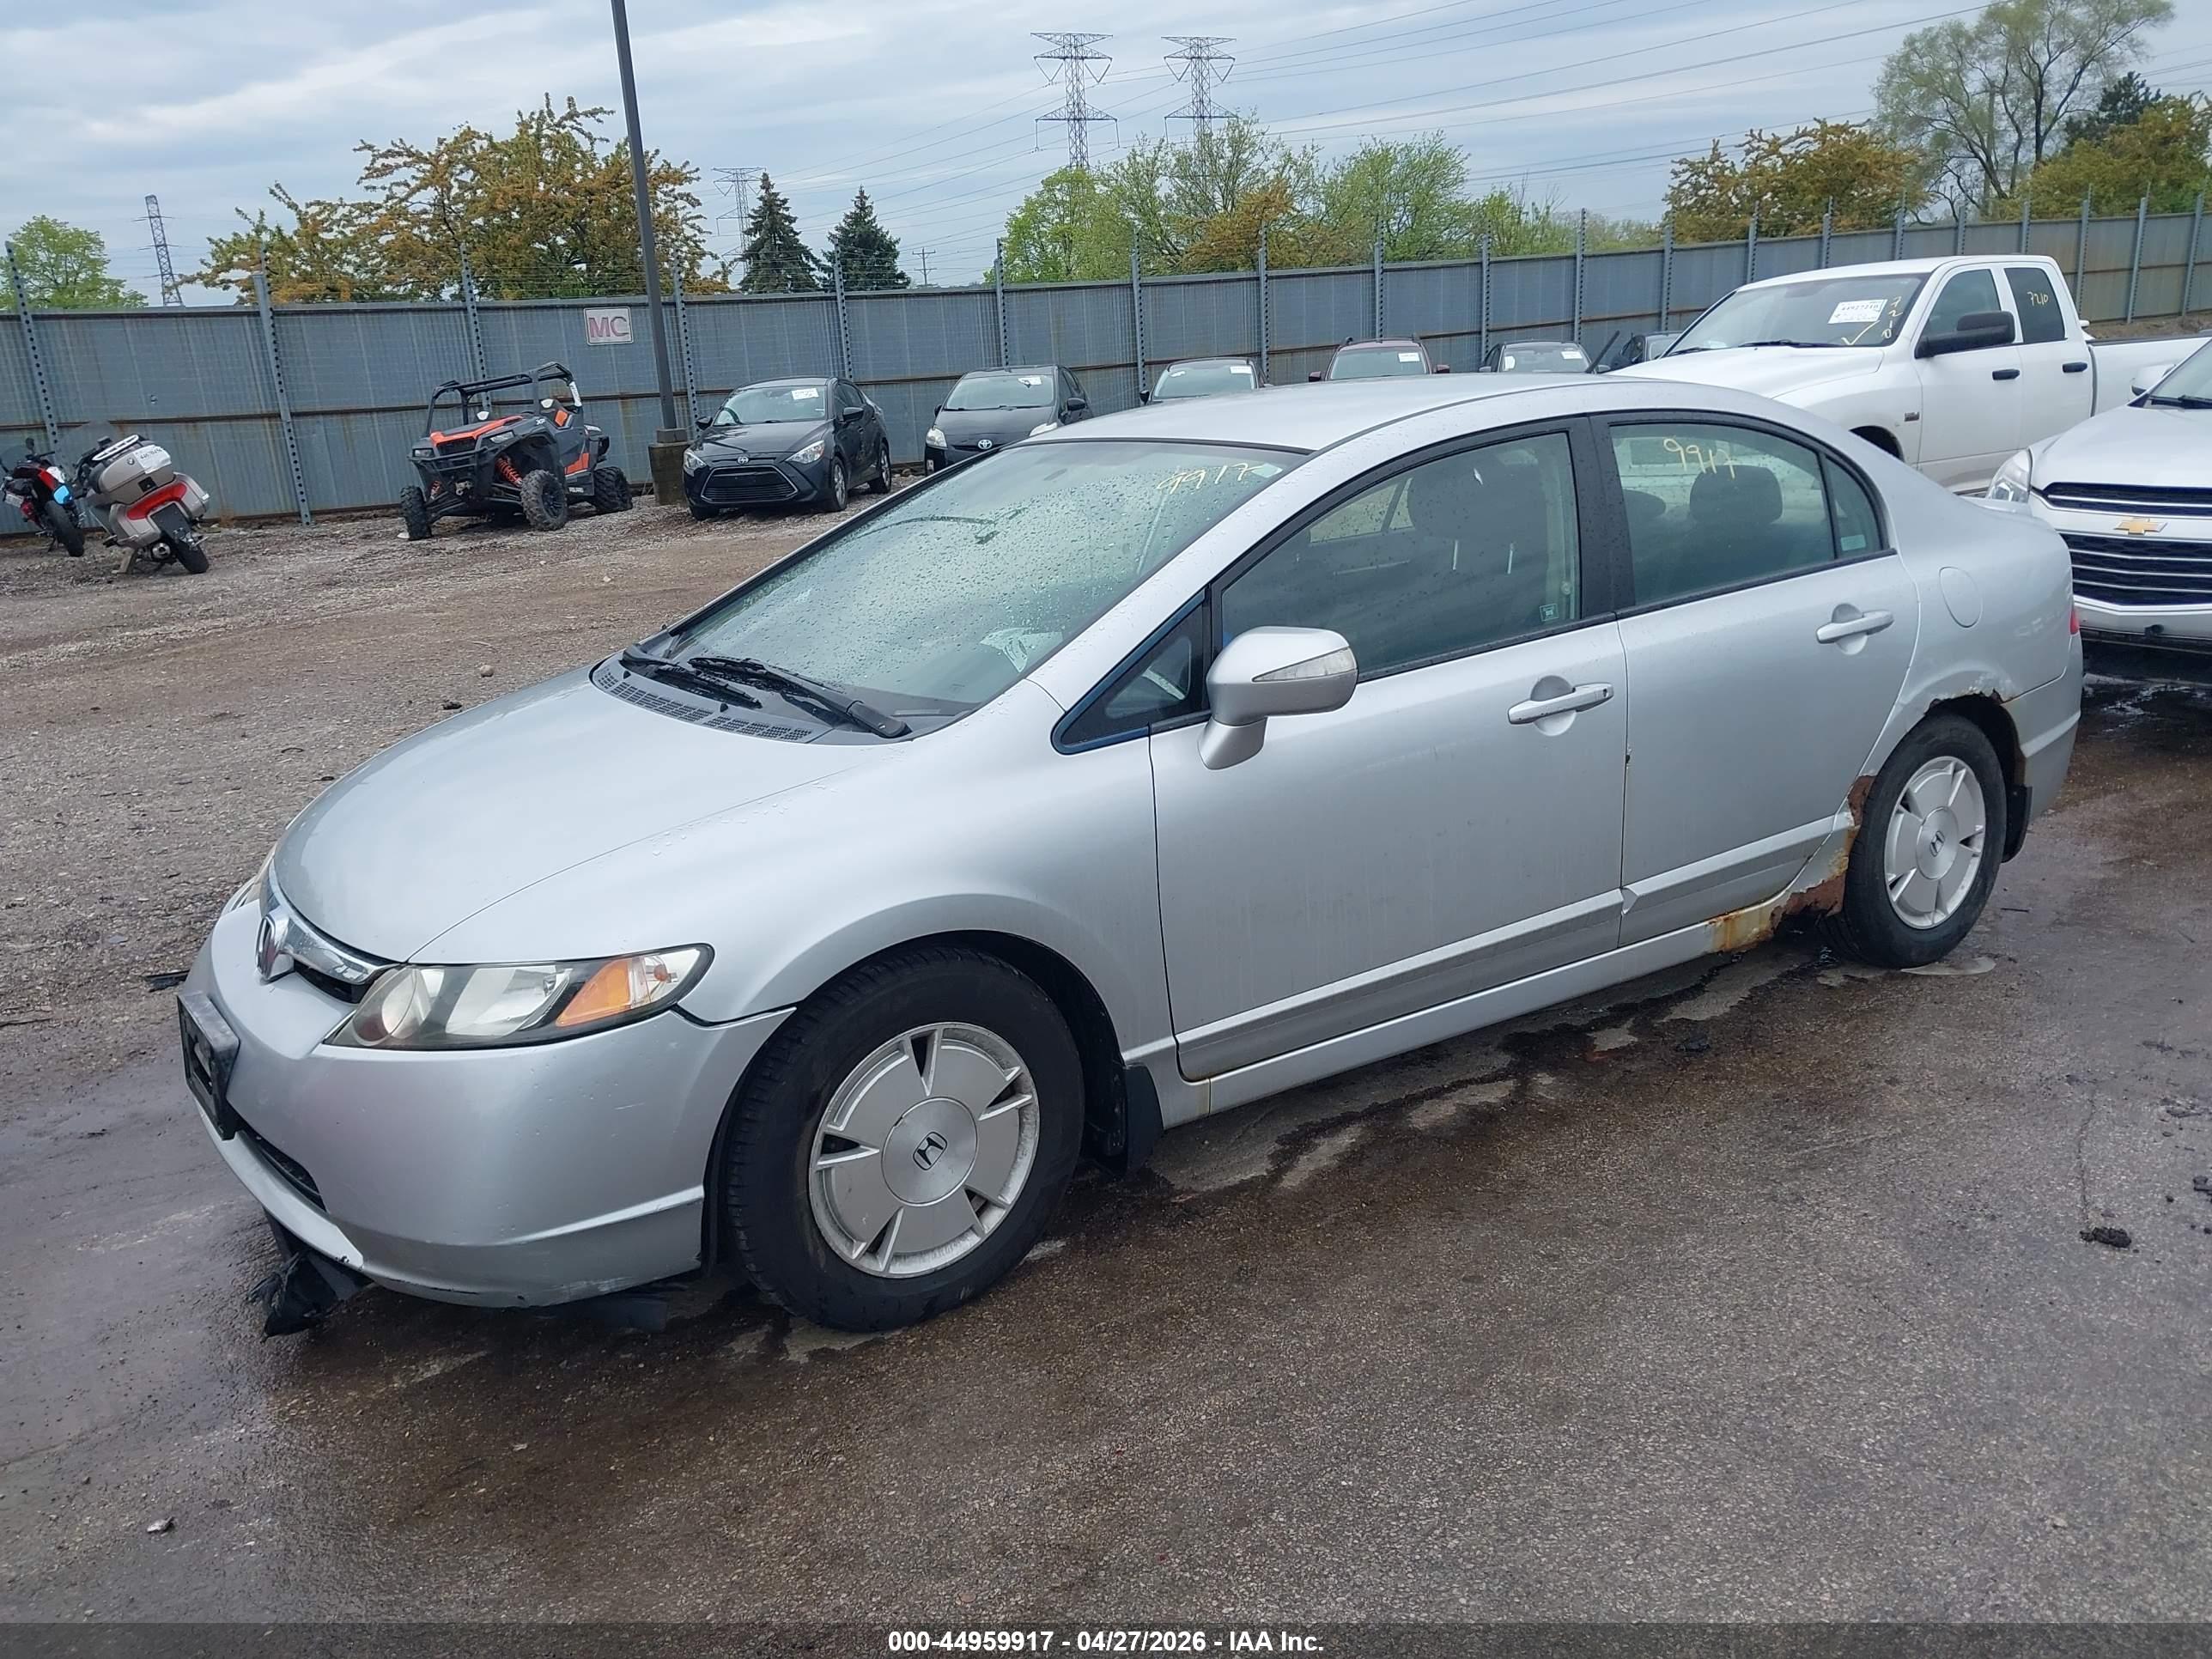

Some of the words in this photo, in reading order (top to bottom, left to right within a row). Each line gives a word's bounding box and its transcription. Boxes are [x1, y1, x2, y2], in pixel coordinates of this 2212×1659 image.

[588, 316, 629, 337] MC
[1663, 438, 1735, 479] 9917
[1156, 463, 1264, 495] 9917
